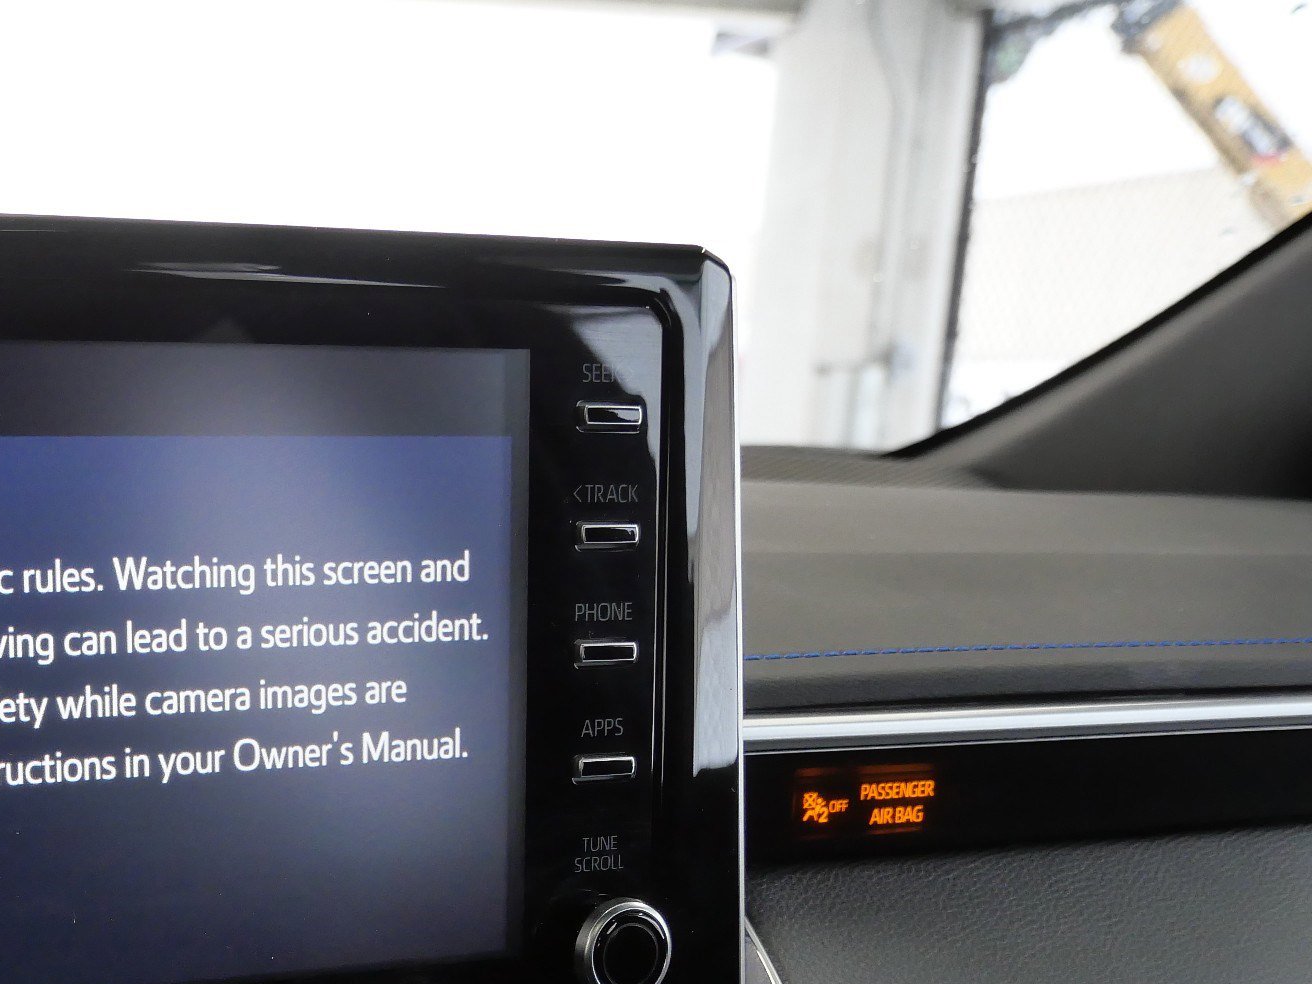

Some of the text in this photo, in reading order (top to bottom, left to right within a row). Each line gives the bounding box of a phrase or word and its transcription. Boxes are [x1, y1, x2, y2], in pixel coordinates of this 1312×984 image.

[585, 484, 639, 503] TRACK
[22, 558, 104, 594] rules.
[112, 555, 255, 595] Watching
[263, 554, 316, 587] this
[323, 557, 413, 585] screen
[420, 549, 470, 583] and
[574, 602, 632, 622] PHONE
[63, 629, 117, 656] can
[126, 618, 187, 654] lead
[196, 621, 228, 651] to
[236, 625, 252, 649] a
[260, 616, 359, 649] serious
[366, 610, 489, 645] accident.
[56, 683, 137, 721] while
[144, 684, 251, 716] camera
[259, 679, 357, 715] images
[365, 679, 408, 705] are
[581, 718, 624, 738] APPS
[124, 747, 150, 780] in
[157, 749, 226, 784] your
[232, 730, 354, 772] Owner's
[361, 726, 469, 763] Manual.
[860, 780, 935, 801] PASSENGER
[828, 799, 849, 813] OFF
[869, 805, 924, 826] AIR BAG
[583, 835, 618, 852] TUNE
[574, 854, 624, 873] SCROLL
